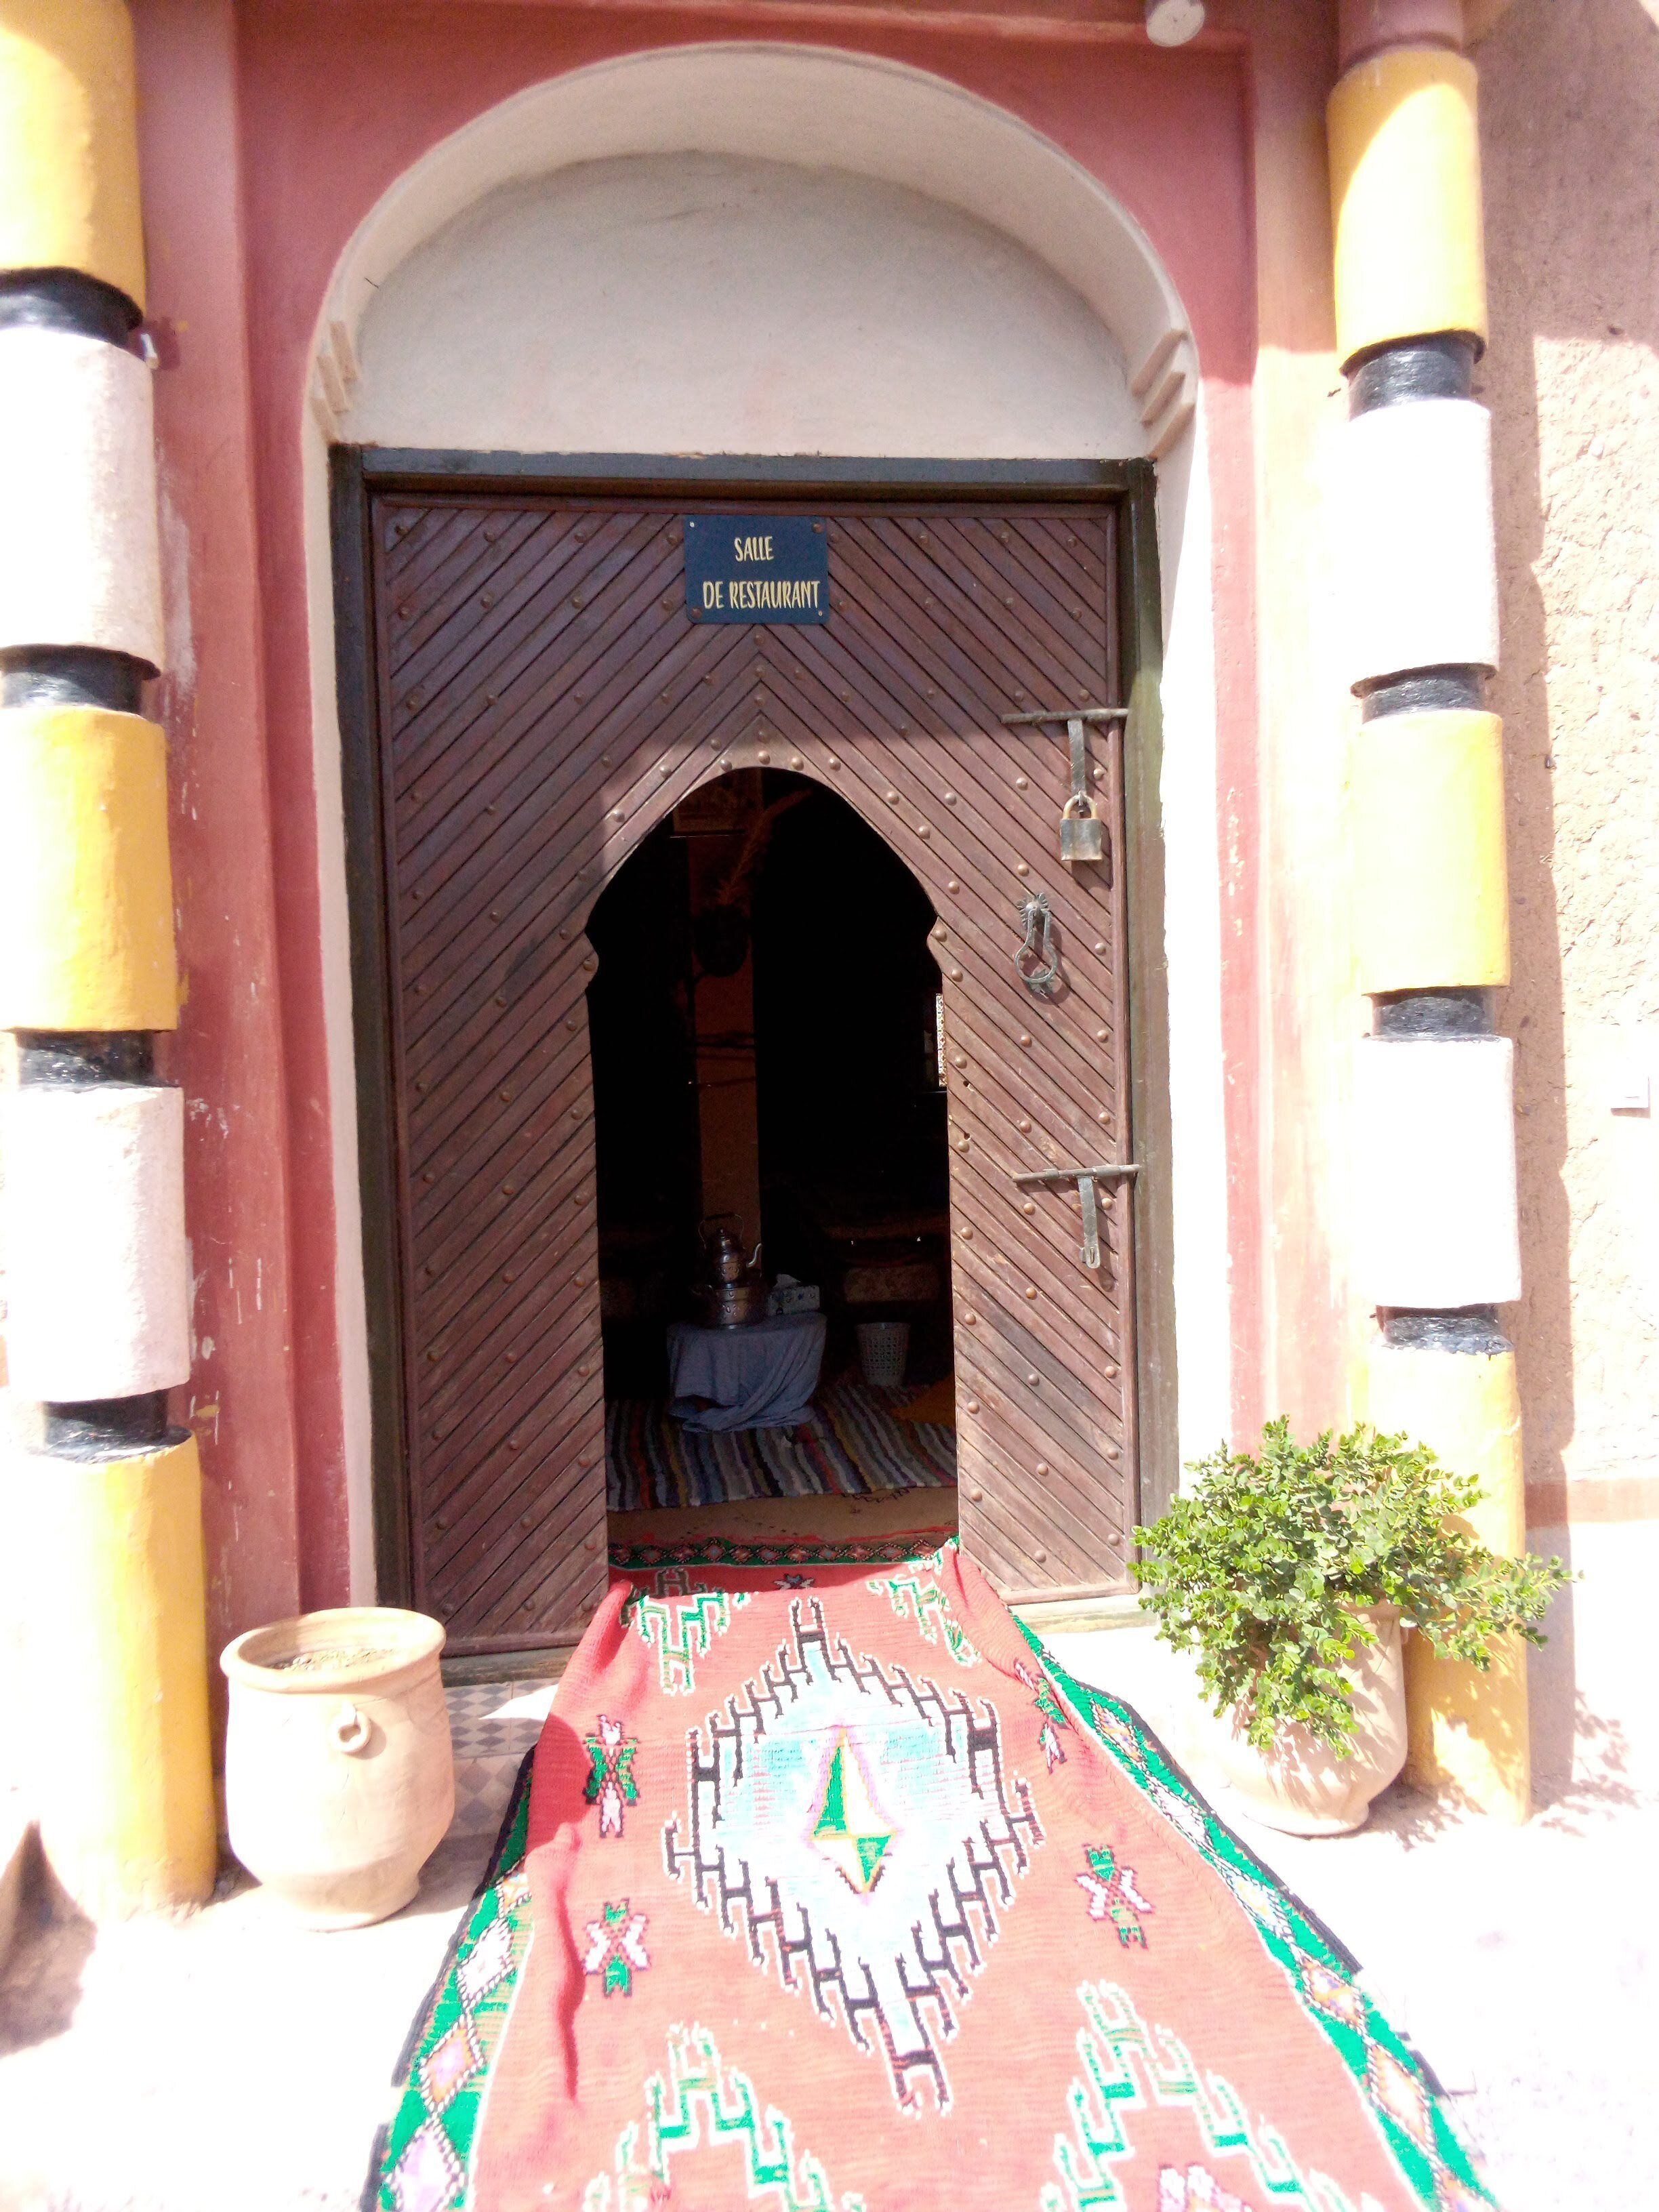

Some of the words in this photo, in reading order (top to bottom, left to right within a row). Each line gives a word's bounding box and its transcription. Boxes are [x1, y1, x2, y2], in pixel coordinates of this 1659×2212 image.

[734, 536, 774, 562] SALLE
[703, 581, 724, 609] DE
[729, 580, 821, 609] RESTAURANT
